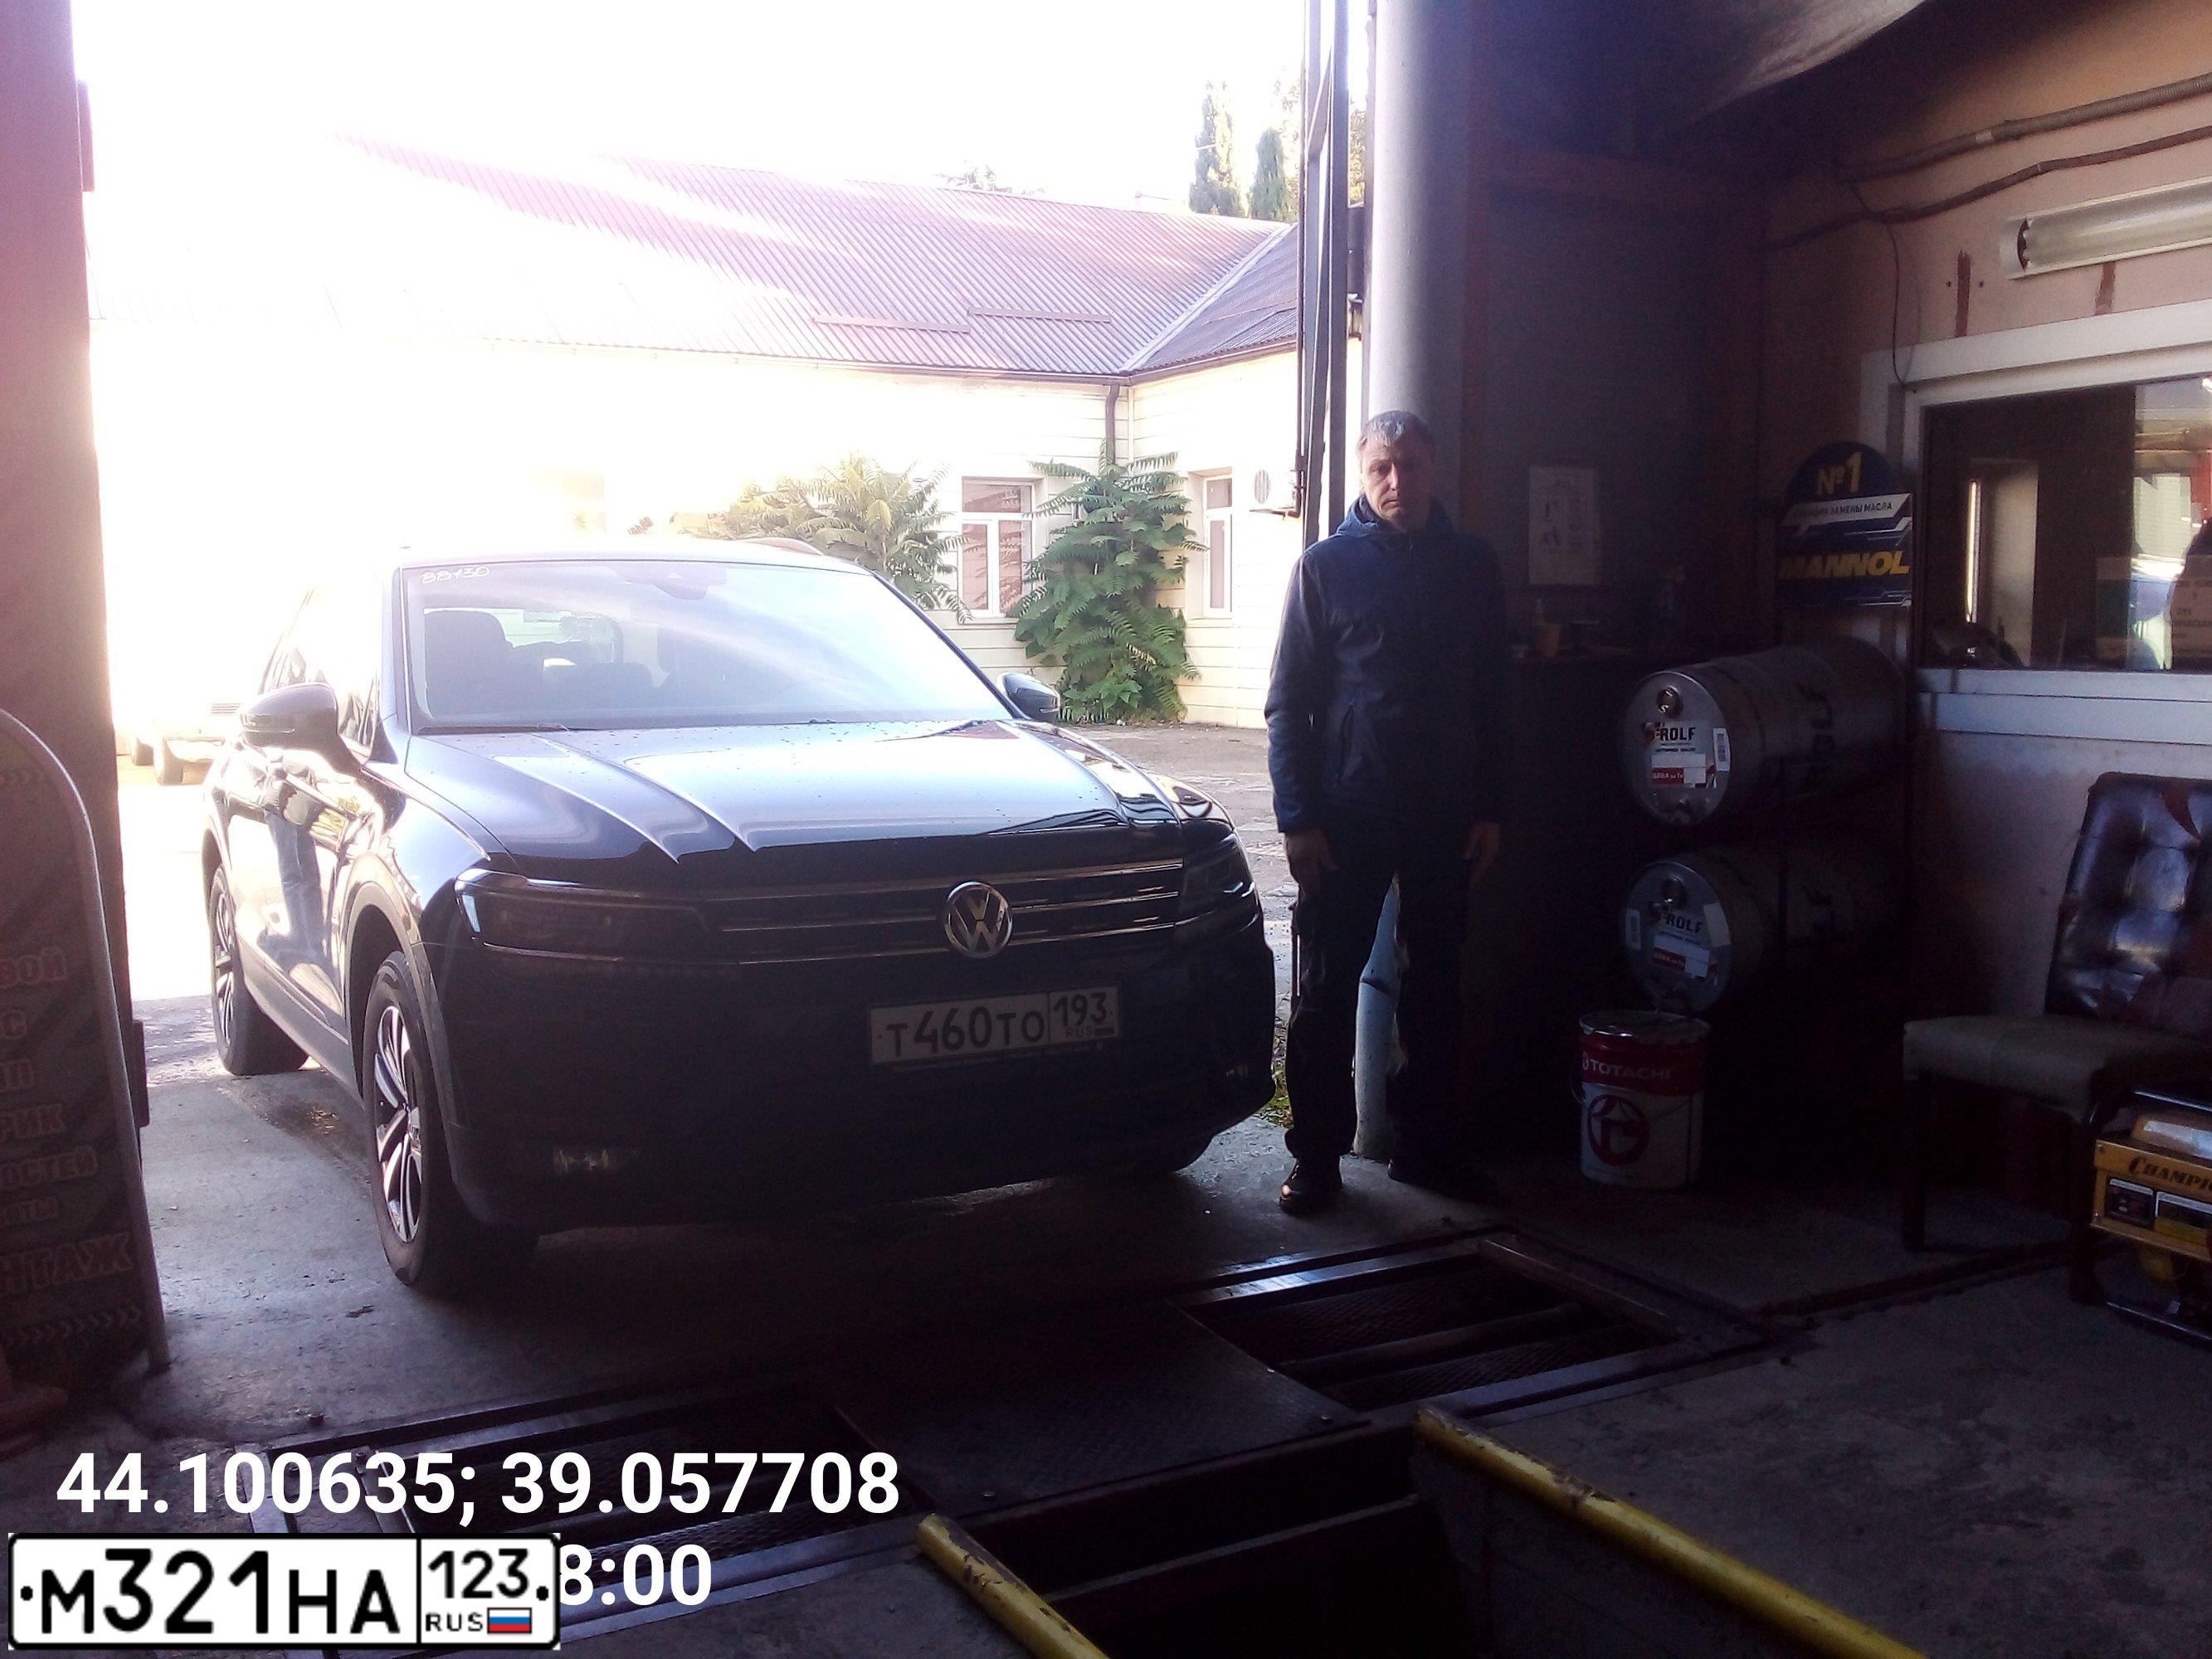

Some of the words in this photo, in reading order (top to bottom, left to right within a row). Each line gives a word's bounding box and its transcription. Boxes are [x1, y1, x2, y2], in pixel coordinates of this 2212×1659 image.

[1864, 502, 1893, 513] МАСЛА
[1780, 551, 1910, 580] MANNOL
[1659, 727, 1696, 741] ROLF
[1666, 913, 1704, 934] ROLF
[1053, 991, 1108, 1028] 193
[1065, 1025, 1094, 1039] RUS
[1589, 1058, 1672, 1080] TOTACHI
